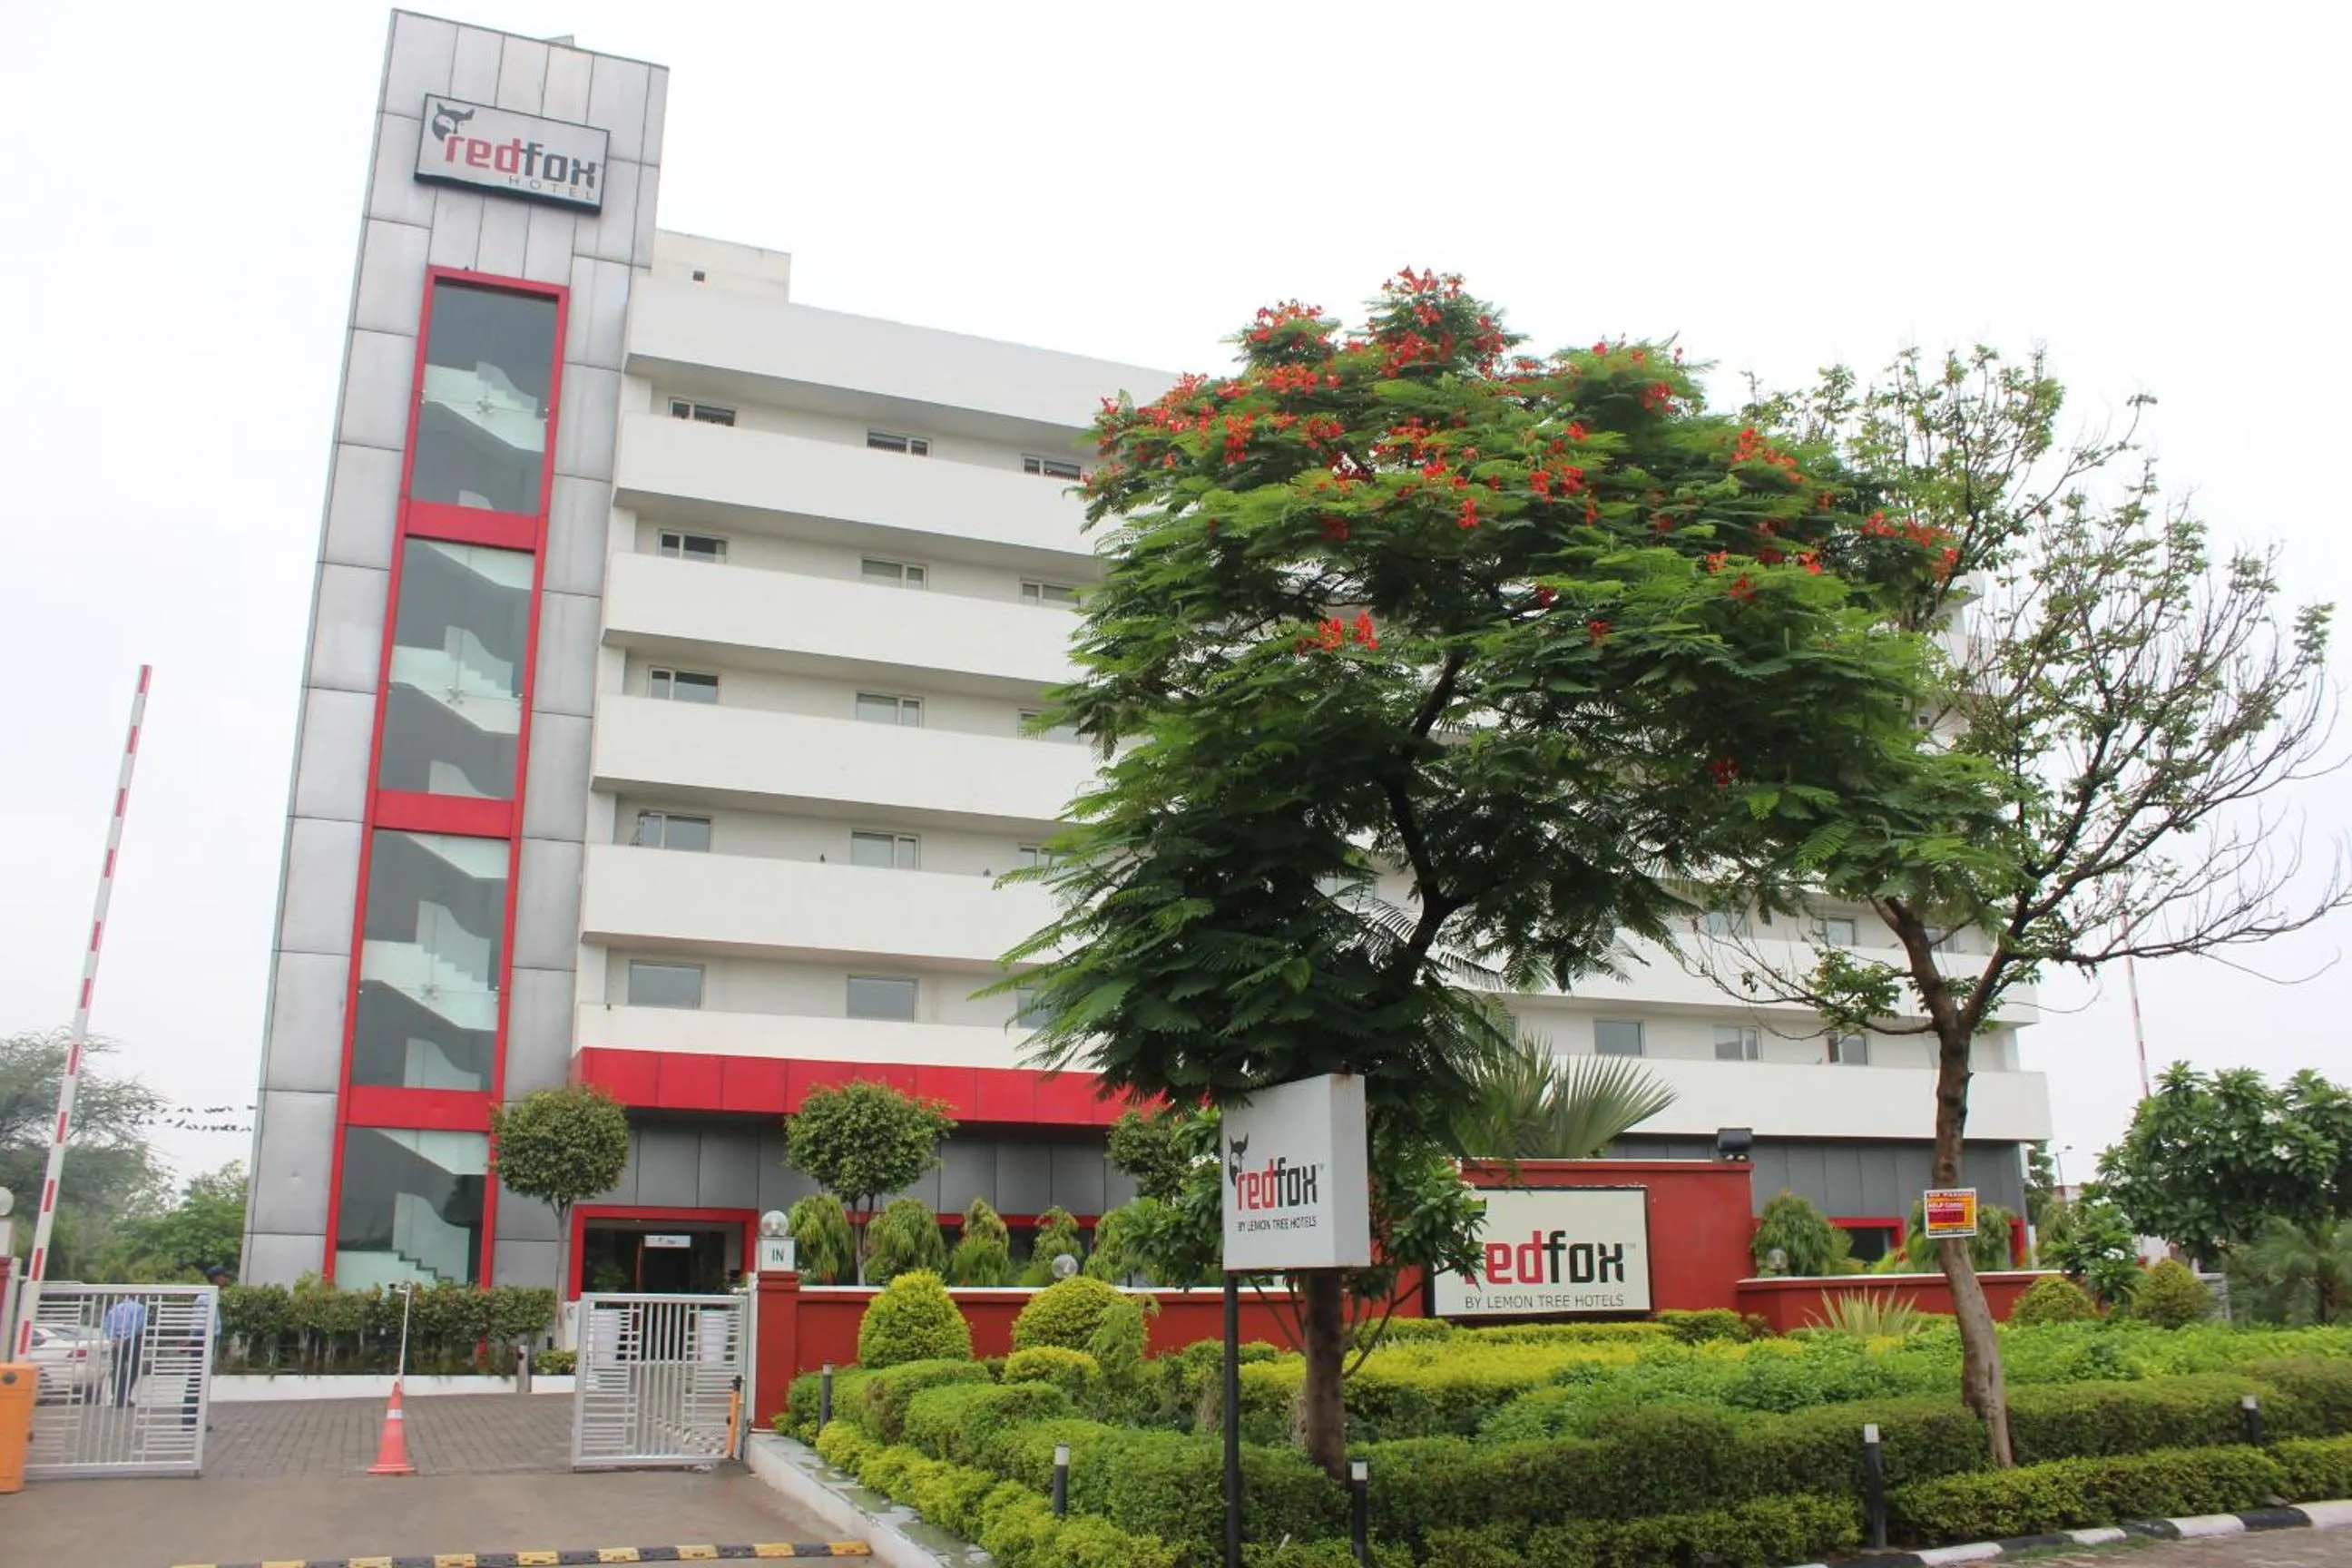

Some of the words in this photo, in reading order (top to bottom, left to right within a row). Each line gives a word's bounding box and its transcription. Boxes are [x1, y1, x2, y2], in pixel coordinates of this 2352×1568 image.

[445, 135, 597, 189] redfox
[508, 174, 595, 201] HOTEL
[1236, 1157, 1318, 1211] redfox
[1247, 1219, 1271, 1232] LEMON
[1272, 1217, 1289, 1230] TREE
[1289, 1215, 1318, 1230] HOTELS
[772, 1247, 785, 1262] IN
[1465, 1230, 1624, 1285] edfox
[1465, 1296, 1482, 1308] BY
[1486, 1295, 1534, 1308] LEMON
[1538, 1294, 1571, 1308] TREE
[1574, 1293, 1624, 1308] HOTELS
